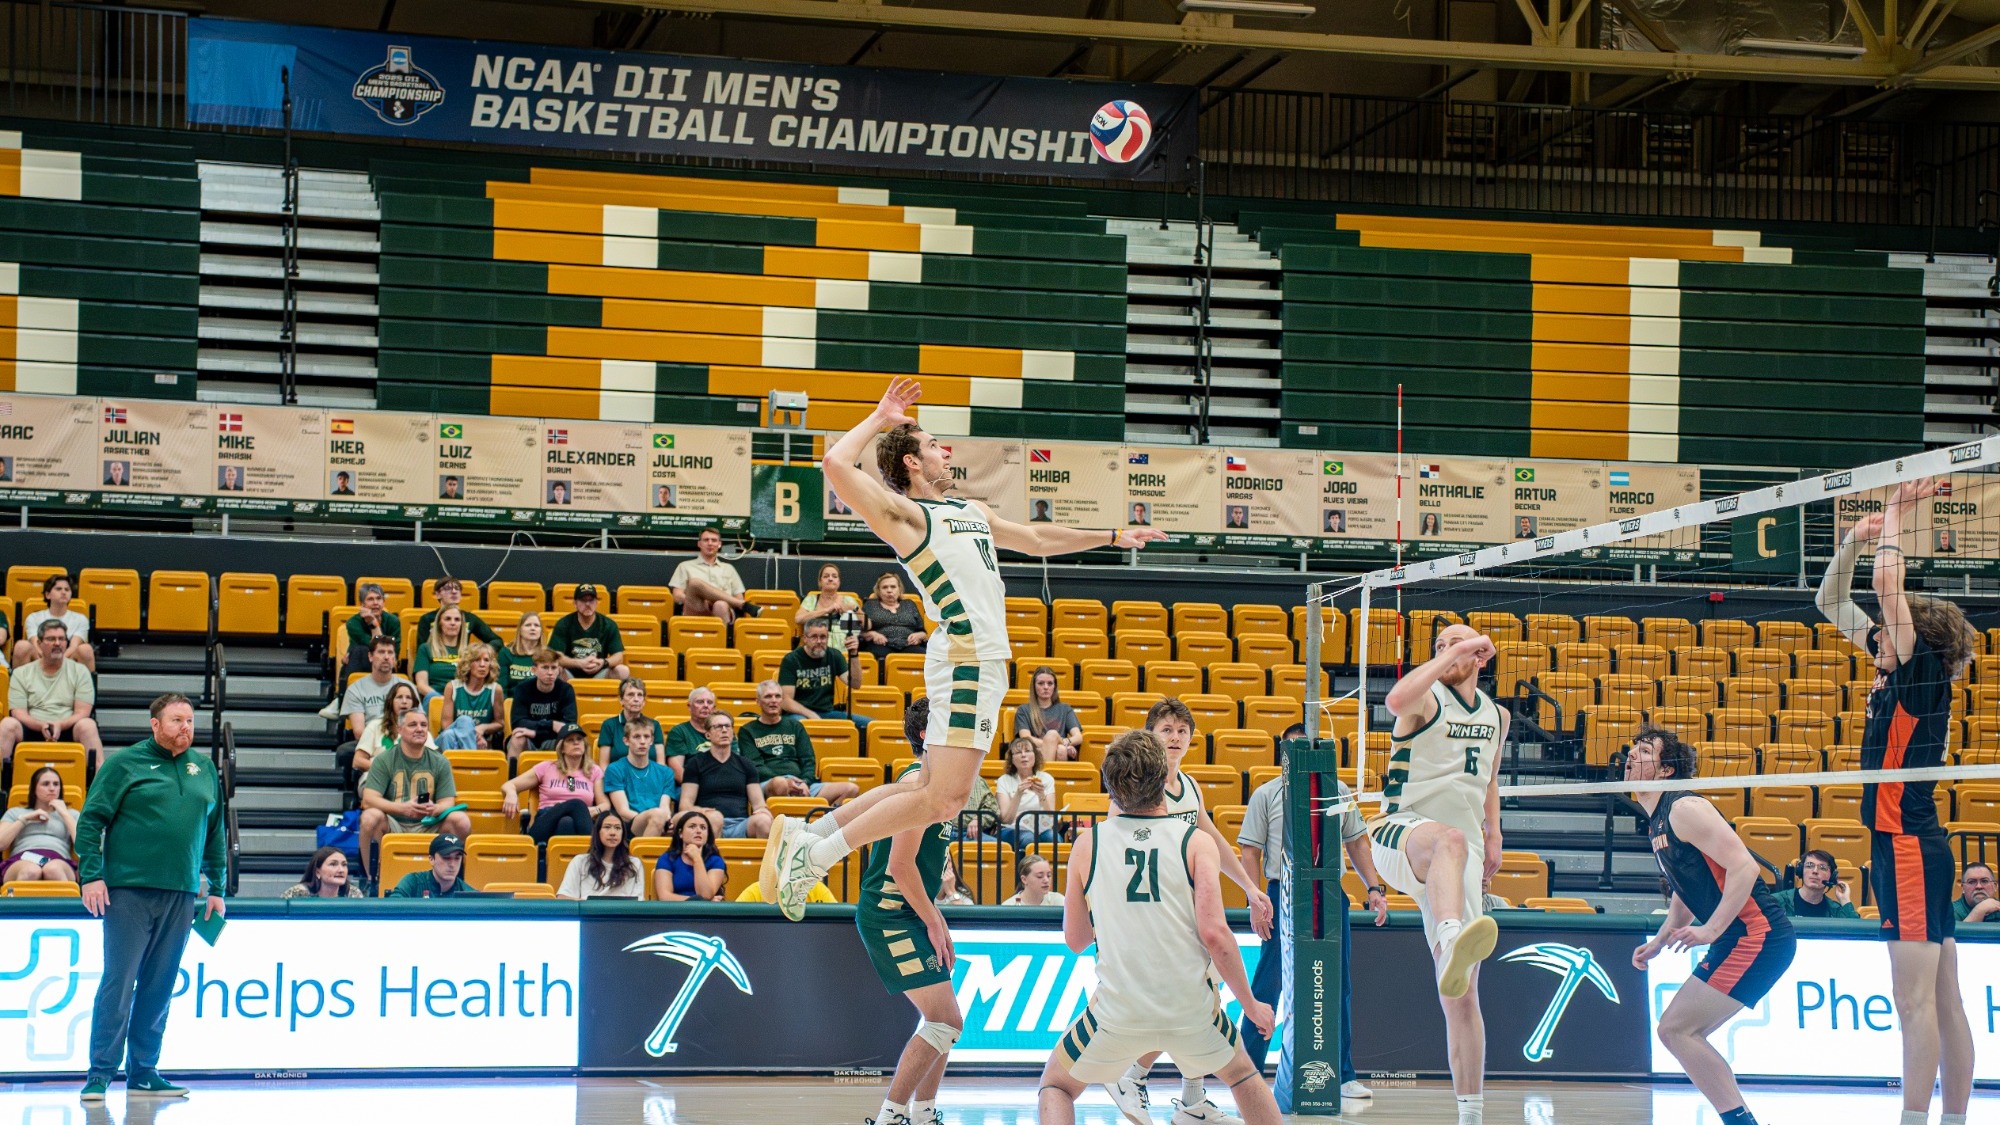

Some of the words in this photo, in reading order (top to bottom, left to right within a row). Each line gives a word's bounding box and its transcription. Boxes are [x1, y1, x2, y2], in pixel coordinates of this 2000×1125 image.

[613, 65, 690, 102] DII
[356, 84, 442, 102] CHAMPIONSHIP
[470, 93, 755, 145] BASKETBALL
[0, 425, 34, 440] AAC
[104, 429, 161, 446] JULIAN
[218, 435, 255, 450] MIKE
[330, 440, 365, 454] IKER
[440, 445, 473, 459] LUIZ
[547, 450, 636, 466] ALEXANDER
[330, 457, 366, 466] BERMEJO
[439, 461, 467, 470] BERNIS
[652, 454, 713, 469] JULIANO
[1029, 469, 1070, 484] KHIBA
[1128, 473, 1166, 487] MARK
[1226, 476, 1284, 491] RODRIGO
[1128, 489, 1166, 497] TOMASOVIC
[1323, 480, 1357, 494] JOAO
[1419, 483, 1485, 499] NATHALIE
[1514, 487, 1557, 501] ARTUR
[775, 481, 801, 524] B
[1226, 492, 1253, 500] VARGAS
[1323, 496, 1345, 504] ALVES
[1346, 497, 1369, 505] VIEIRA
[1419, 499, 1441, 507] BELLO
[1609, 491, 1655, 505] MARCO
[1514, 503, 1541, 511] BECHER
[1838, 499, 1882, 513] OSKAR
[1933, 502, 1977, 516] OSCAR
[950, 519, 990, 534] MINERS
[1757, 516, 1777, 558] C
[363, 694, 383, 703] MIN
[1449, 722, 1496, 740] MINERS
[1463, 746, 1481, 777] 6
[394, 769, 429, 799] 10
[1124, 847, 1161, 902] 21
[1311, 959, 1325, 998] sports
[380, 962, 574, 1018] Health
[1795, 977, 1901, 1032] Phe
[1311, 1001, 1325, 1051] imports
